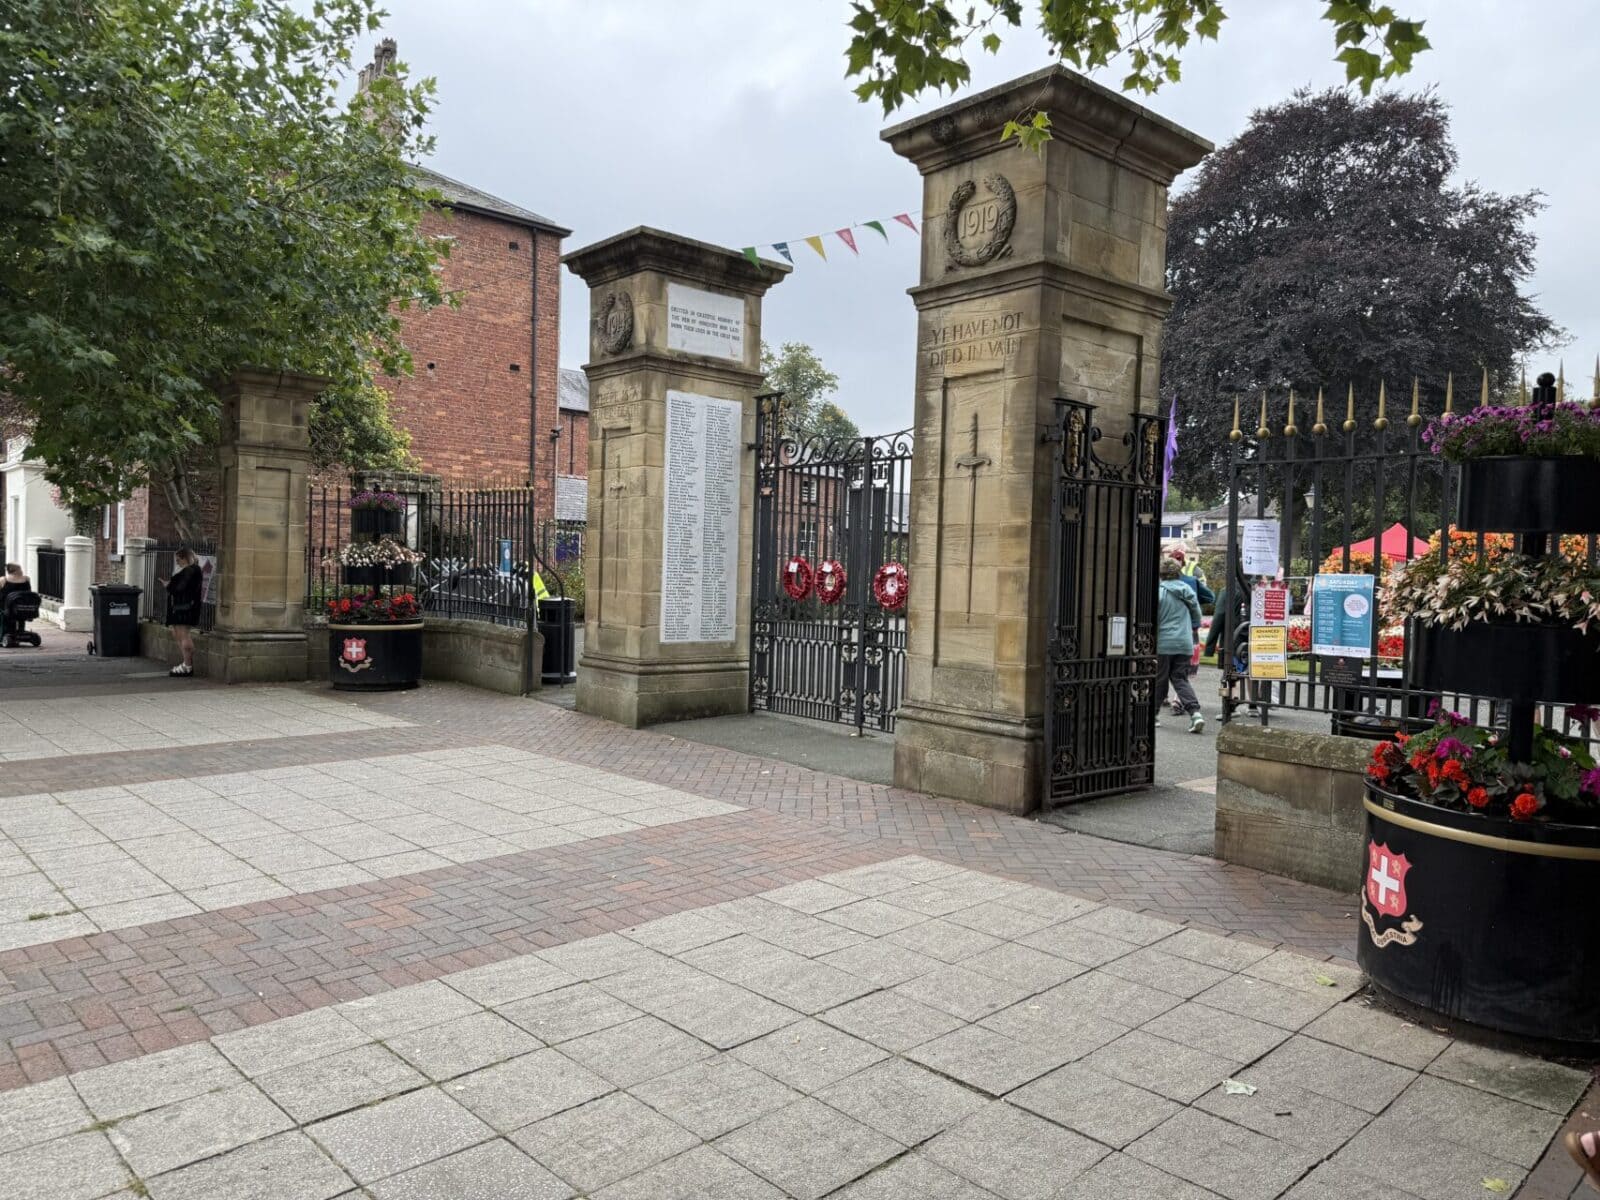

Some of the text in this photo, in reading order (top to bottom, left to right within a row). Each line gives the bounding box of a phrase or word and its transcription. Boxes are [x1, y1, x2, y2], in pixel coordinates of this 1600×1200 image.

[960, 203, 999, 240] 1919
[952, 318, 990, 341] HAVE
[991, 312, 1024, 334] NOT
[930, 347, 963, 368] DIED
